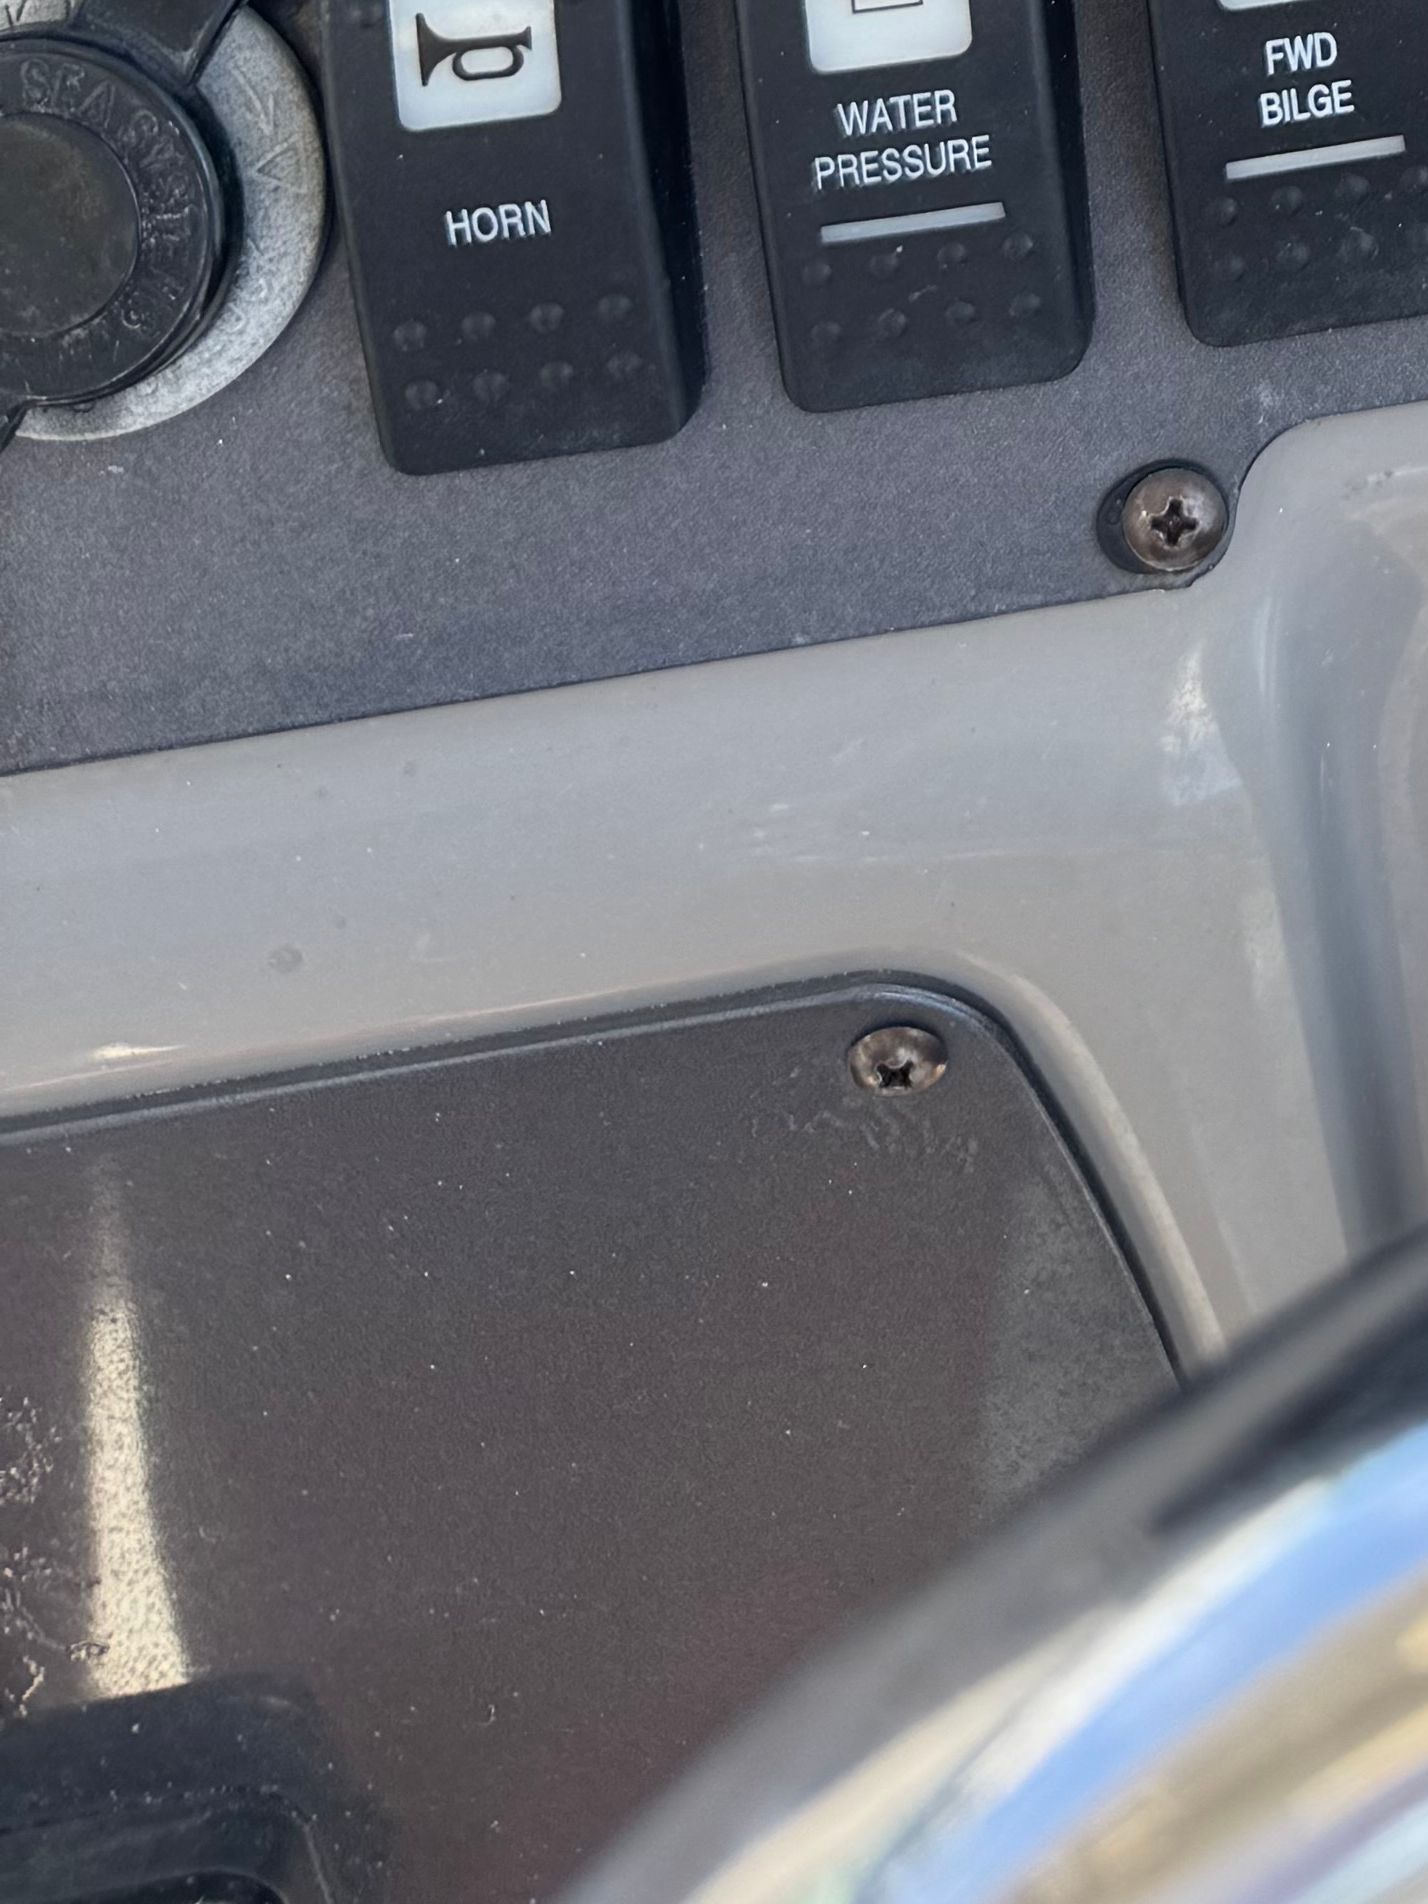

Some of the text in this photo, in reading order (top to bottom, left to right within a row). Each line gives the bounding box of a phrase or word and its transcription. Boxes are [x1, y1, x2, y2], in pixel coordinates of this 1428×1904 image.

[1266, 32, 1337, 75] FWD
[837, 90, 957, 137] WATER
[1260, 80, 1354, 126] BILGE
[814, 136, 992, 190] PRESSURE
[446, 200, 551, 245] HORN
